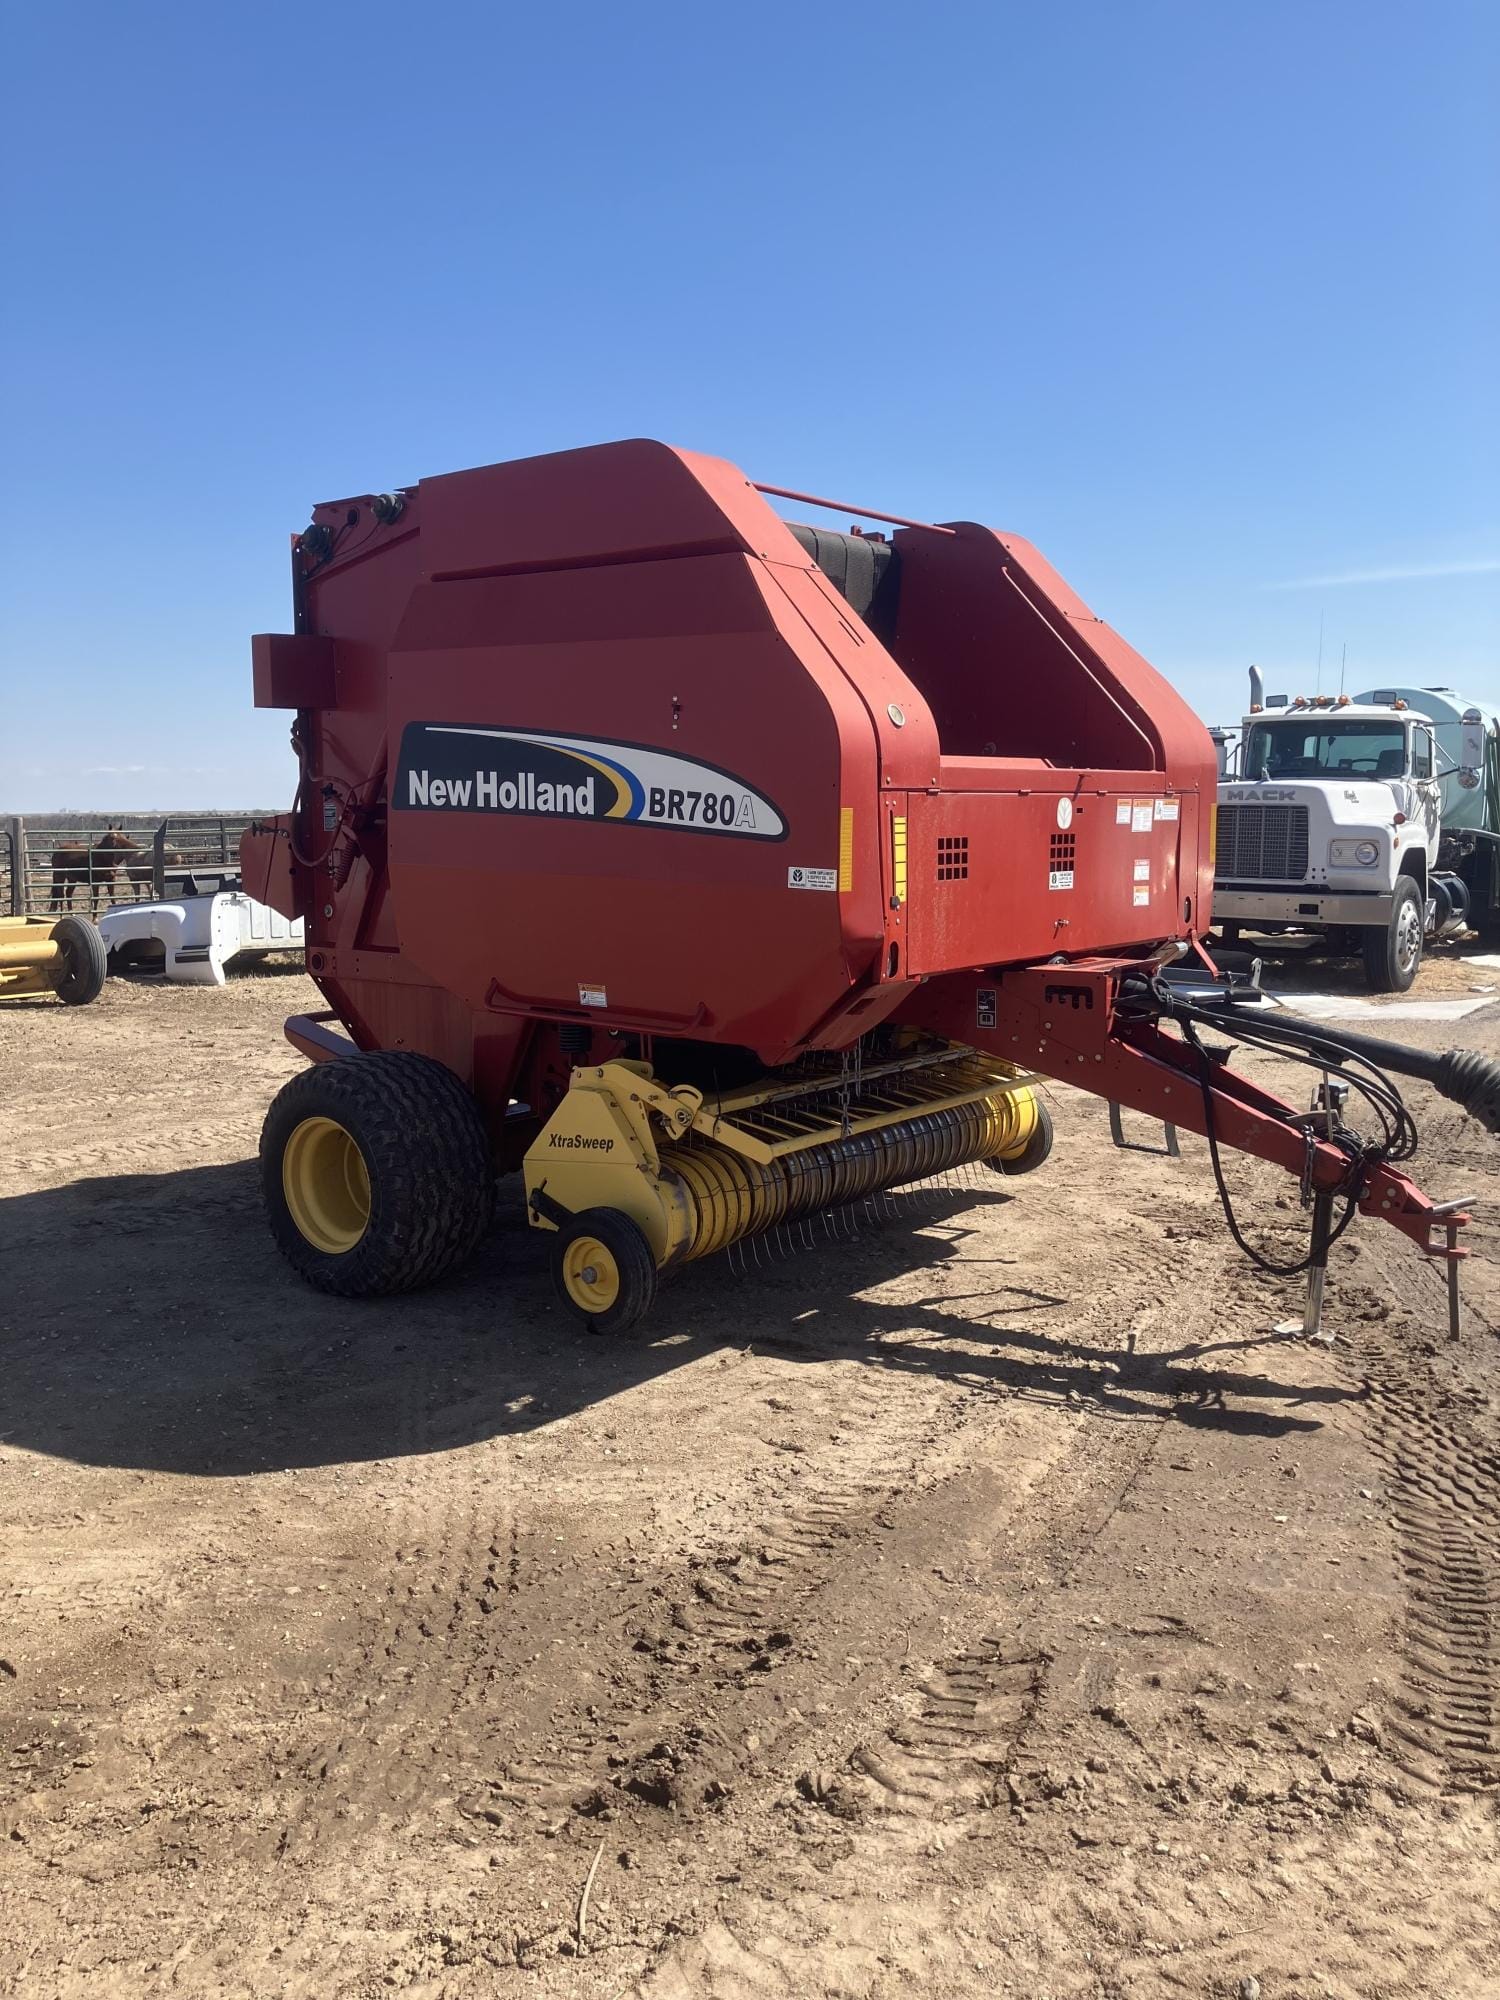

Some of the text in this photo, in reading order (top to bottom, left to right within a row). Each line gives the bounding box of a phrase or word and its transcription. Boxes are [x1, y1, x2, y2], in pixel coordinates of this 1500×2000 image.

[409, 770, 595, 815] New Holland
[649, 787, 756, 828] BR780A
[1227, 790, 1296, 801] MACK
[548, 1133, 614, 1153] XtraSweep
